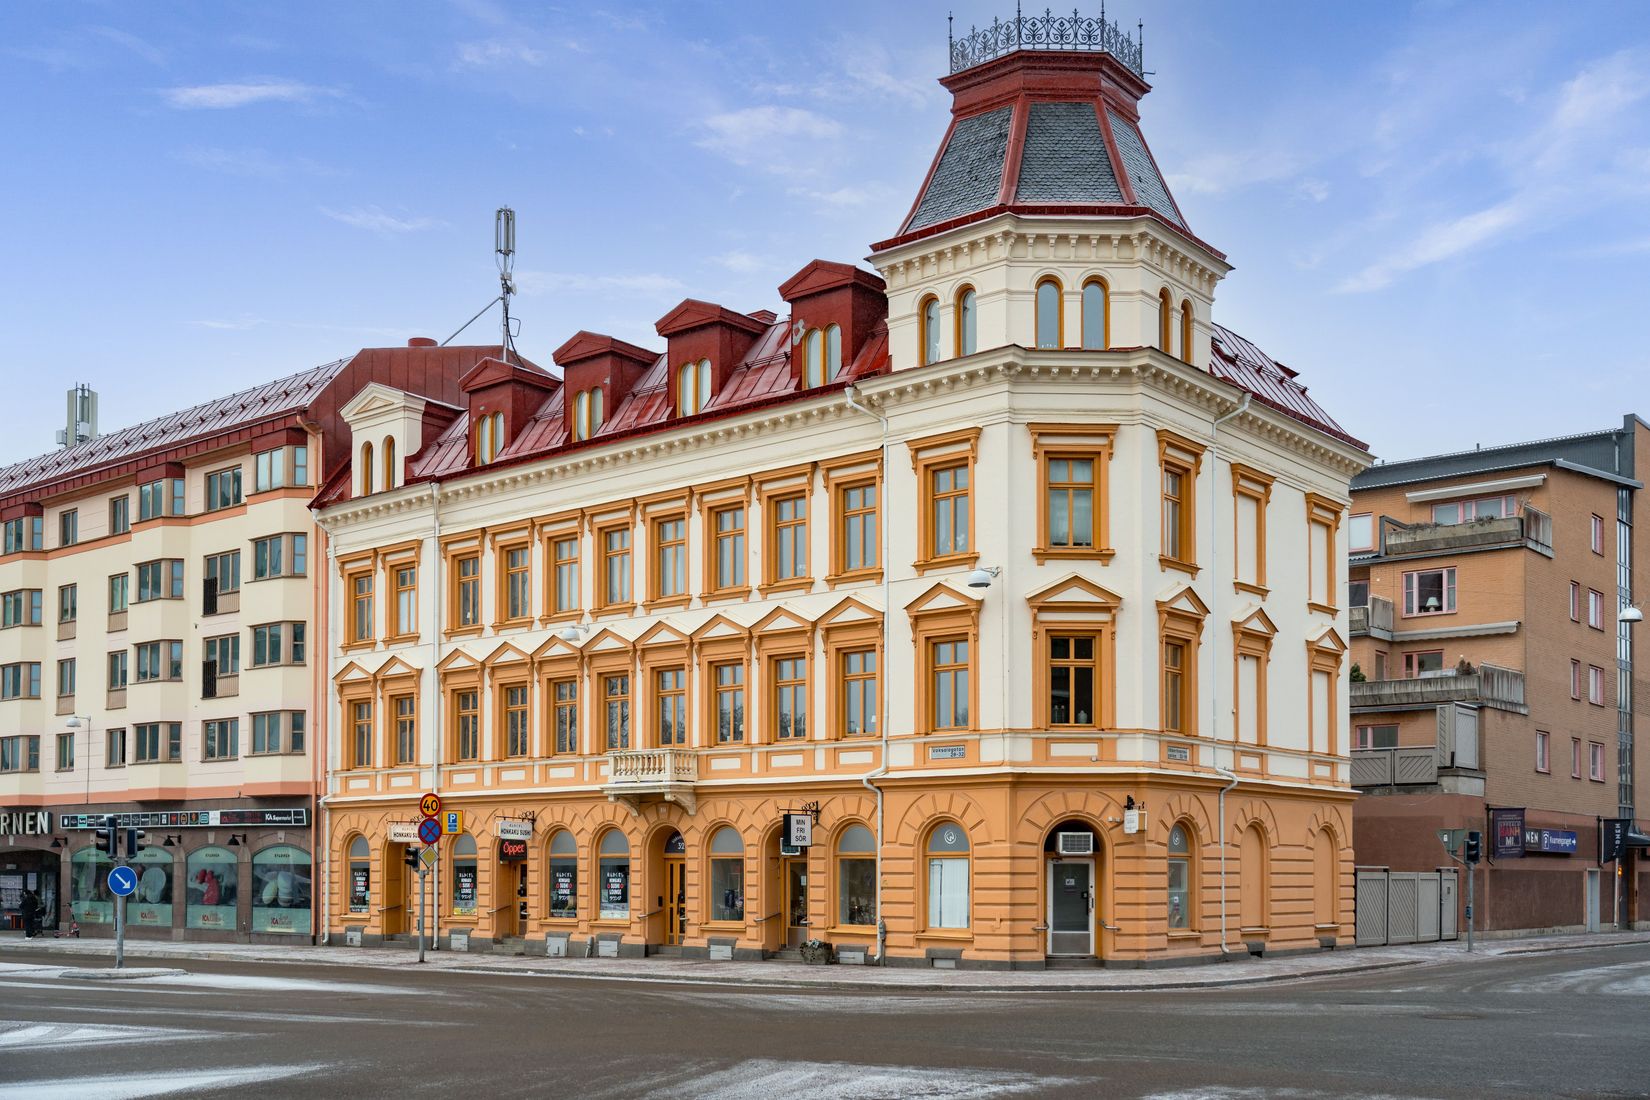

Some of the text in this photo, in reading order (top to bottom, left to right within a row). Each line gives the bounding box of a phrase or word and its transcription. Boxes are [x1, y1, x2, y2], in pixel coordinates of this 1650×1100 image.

[423, 800, 439, 811] 40
[449, 813, 457, 823] P
[0, 812, 48, 835] RNEN
[501, 828, 519, 836] HONKAKU
[677, 842, 685, 850] 32
